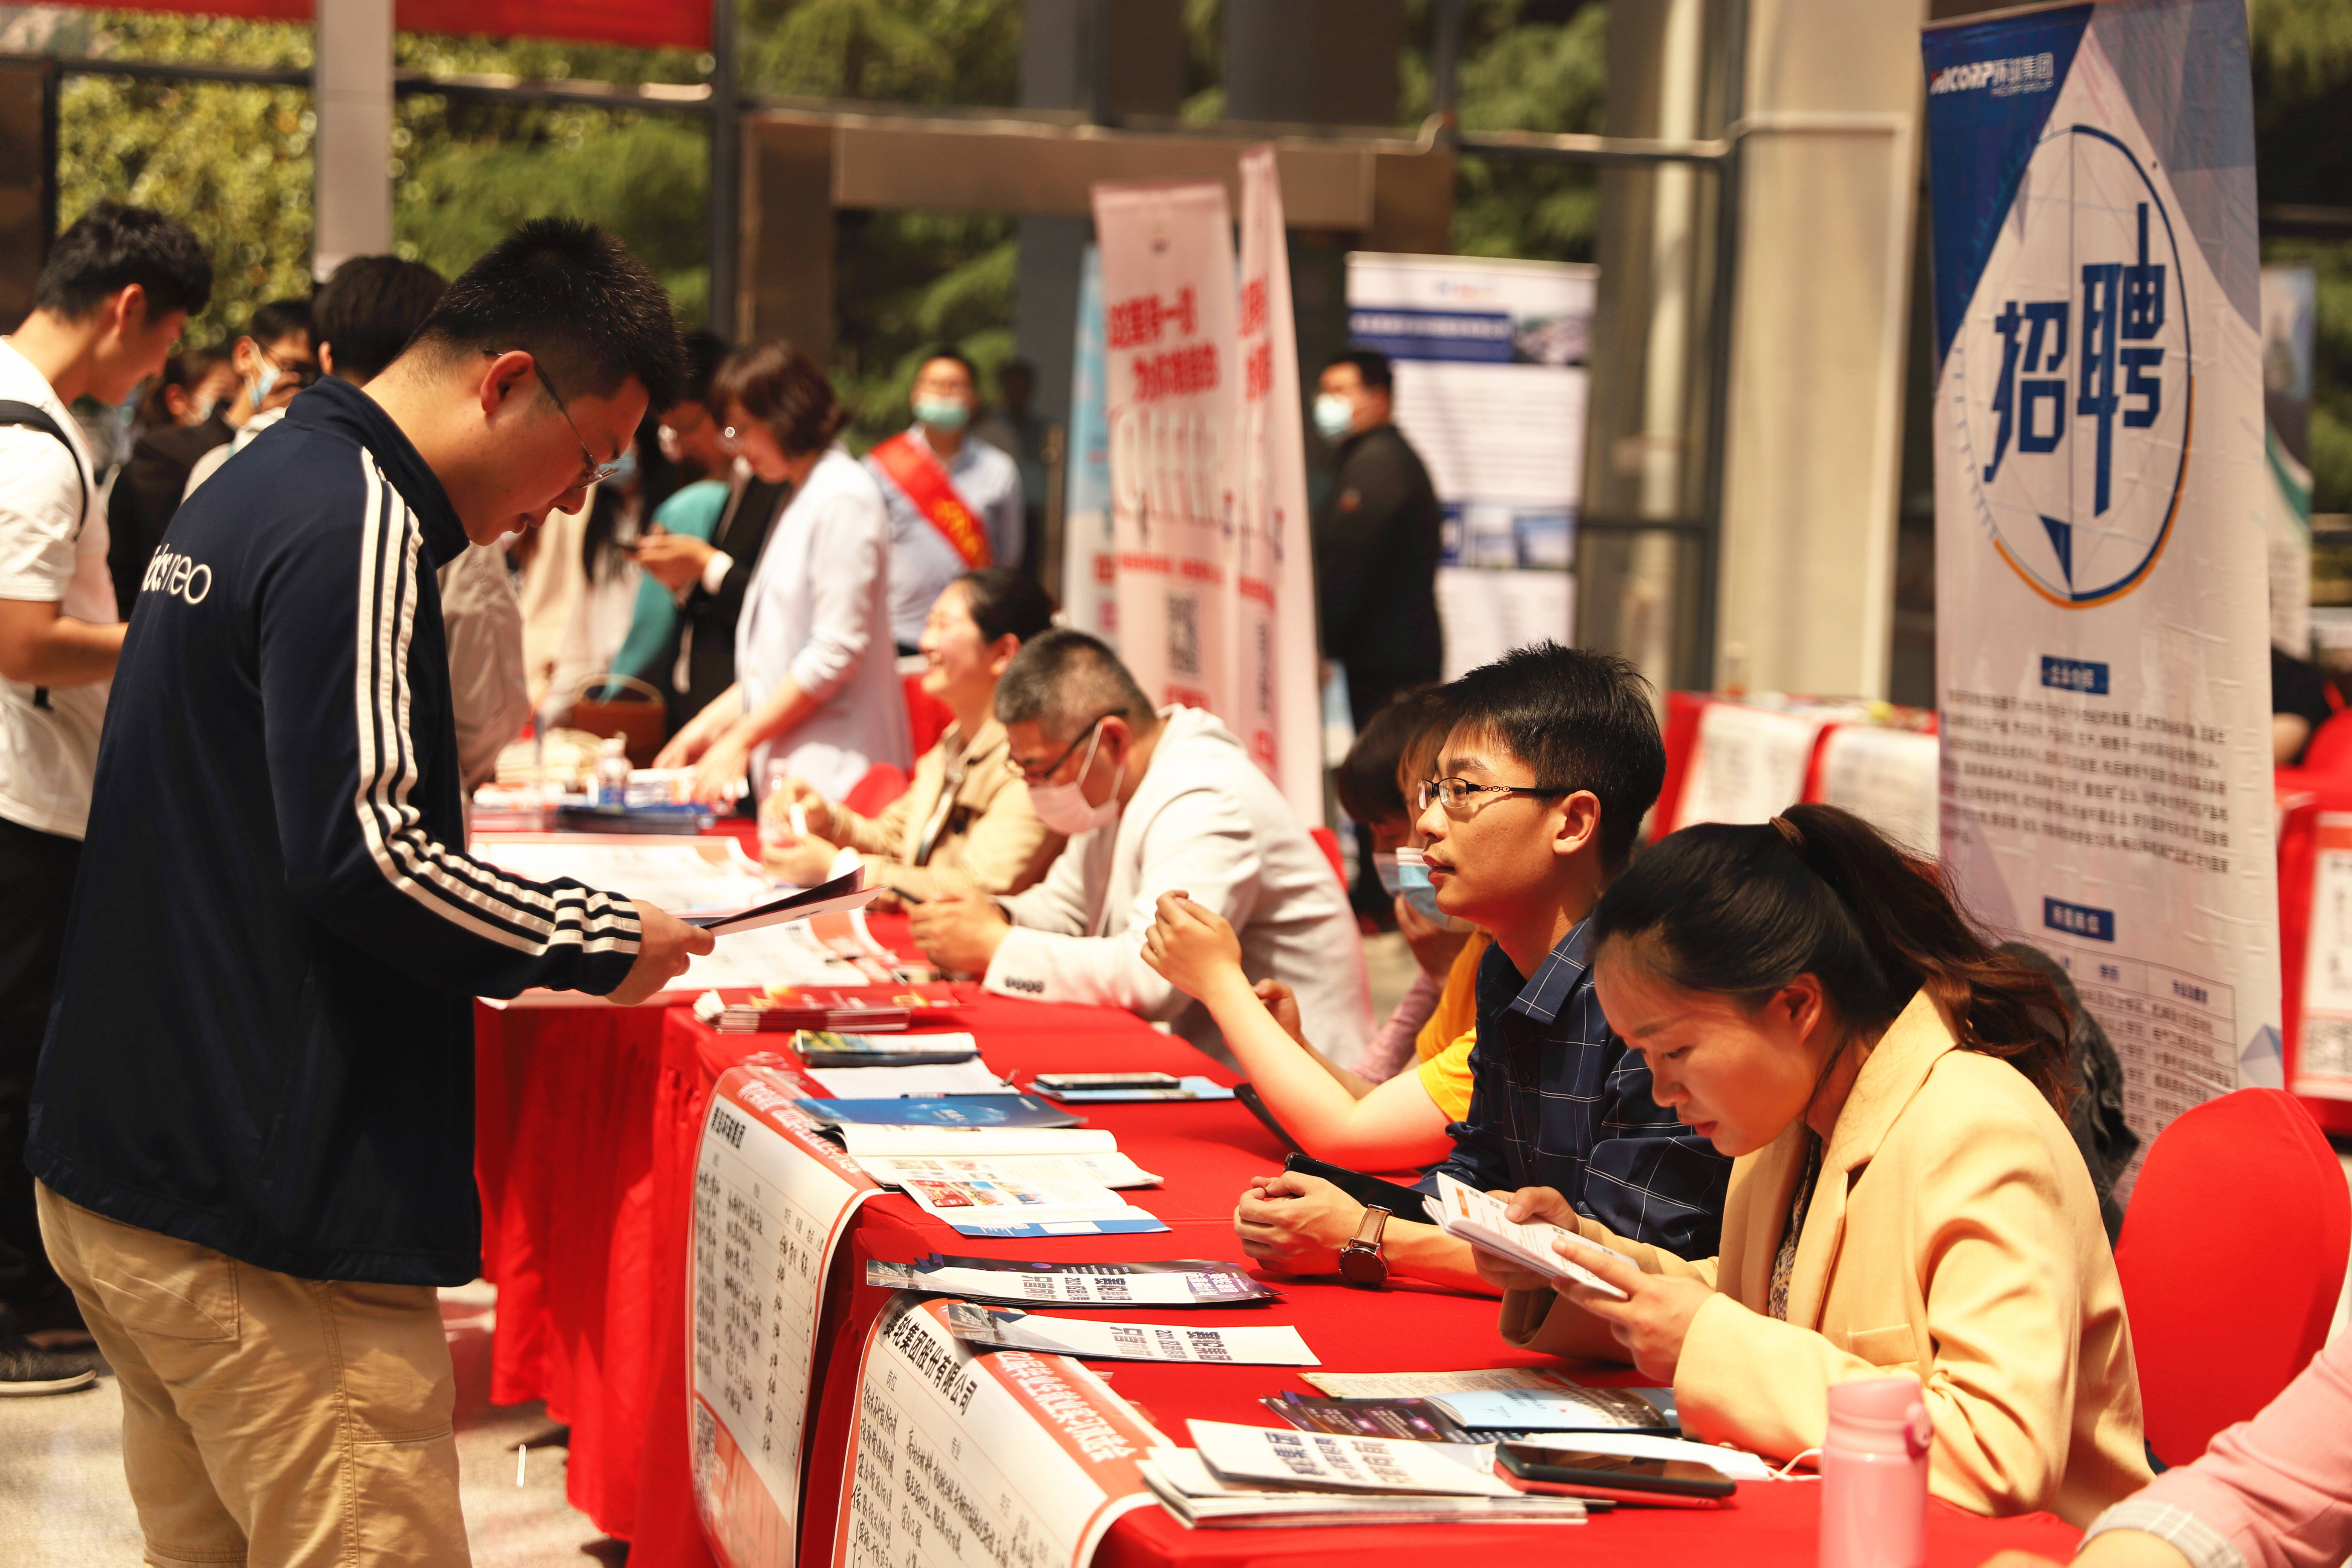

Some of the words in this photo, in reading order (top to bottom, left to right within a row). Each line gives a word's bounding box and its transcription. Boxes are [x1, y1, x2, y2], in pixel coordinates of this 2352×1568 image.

[1984, 202, 2165, 518] 招聘
[1095, 1277, 1133, 1300] 赛轮集团
[1109, 1326, 1155, 1356] 只管向前
[1186, 1331, 1233, 1361] 赛轮集团
[884, 1308, 978, 1416] 赛轮集团股份有限公司
[887, 1369, 897, 1392] 岗位
